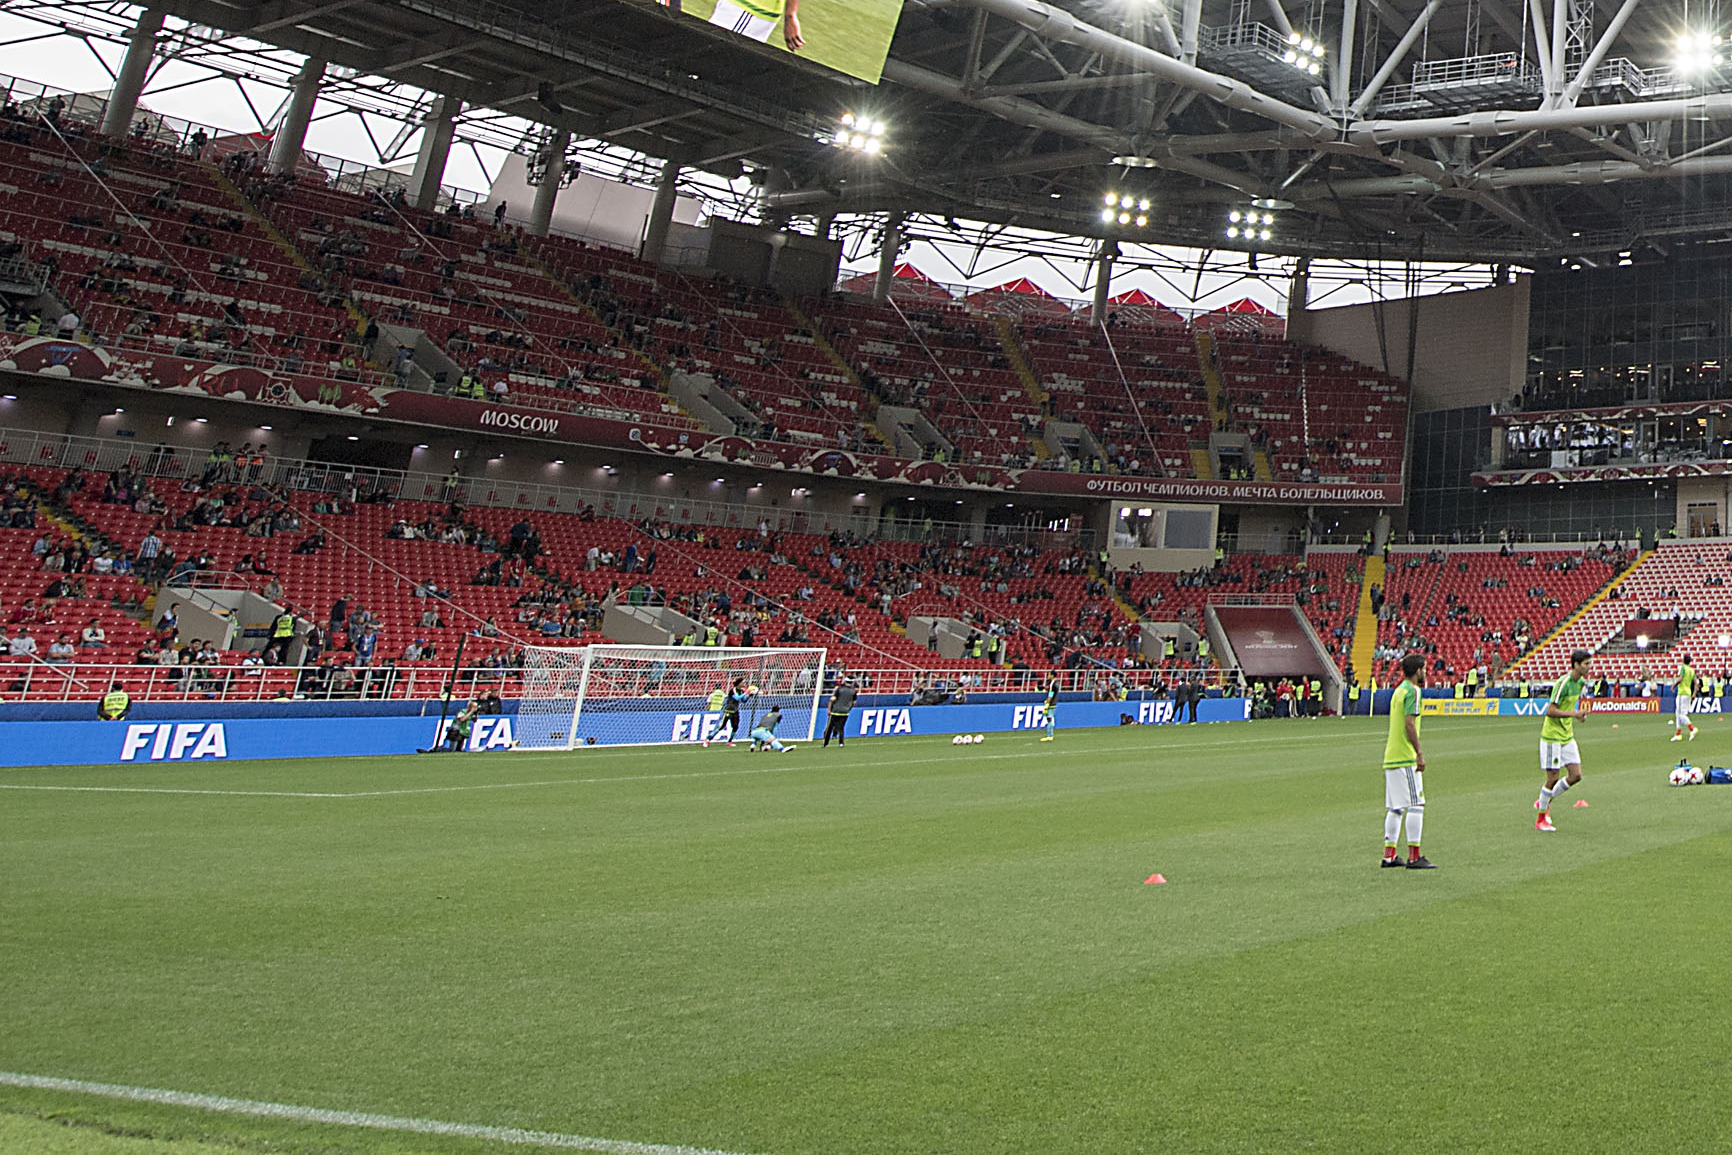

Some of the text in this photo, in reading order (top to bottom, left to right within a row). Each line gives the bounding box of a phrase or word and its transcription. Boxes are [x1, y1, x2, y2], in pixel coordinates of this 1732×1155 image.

[480, 410, 558, 433] MOSCOW
[1087, 480, 1386, 501] ФУТБОЛ ЧЕМПИОНОВ. МЕЧТА БОЛЕЛЬЩИКОВ.
[1139, 702, 1175, 723] FIFA
[1513, 698, 1549, 715] viv
[1592, 701, 1647, 711] McDonald's
[860, 709, 912, 735] FIFA
[120, 723, 227, 760] FIFA
[432, 718, 513, 750] FFA
